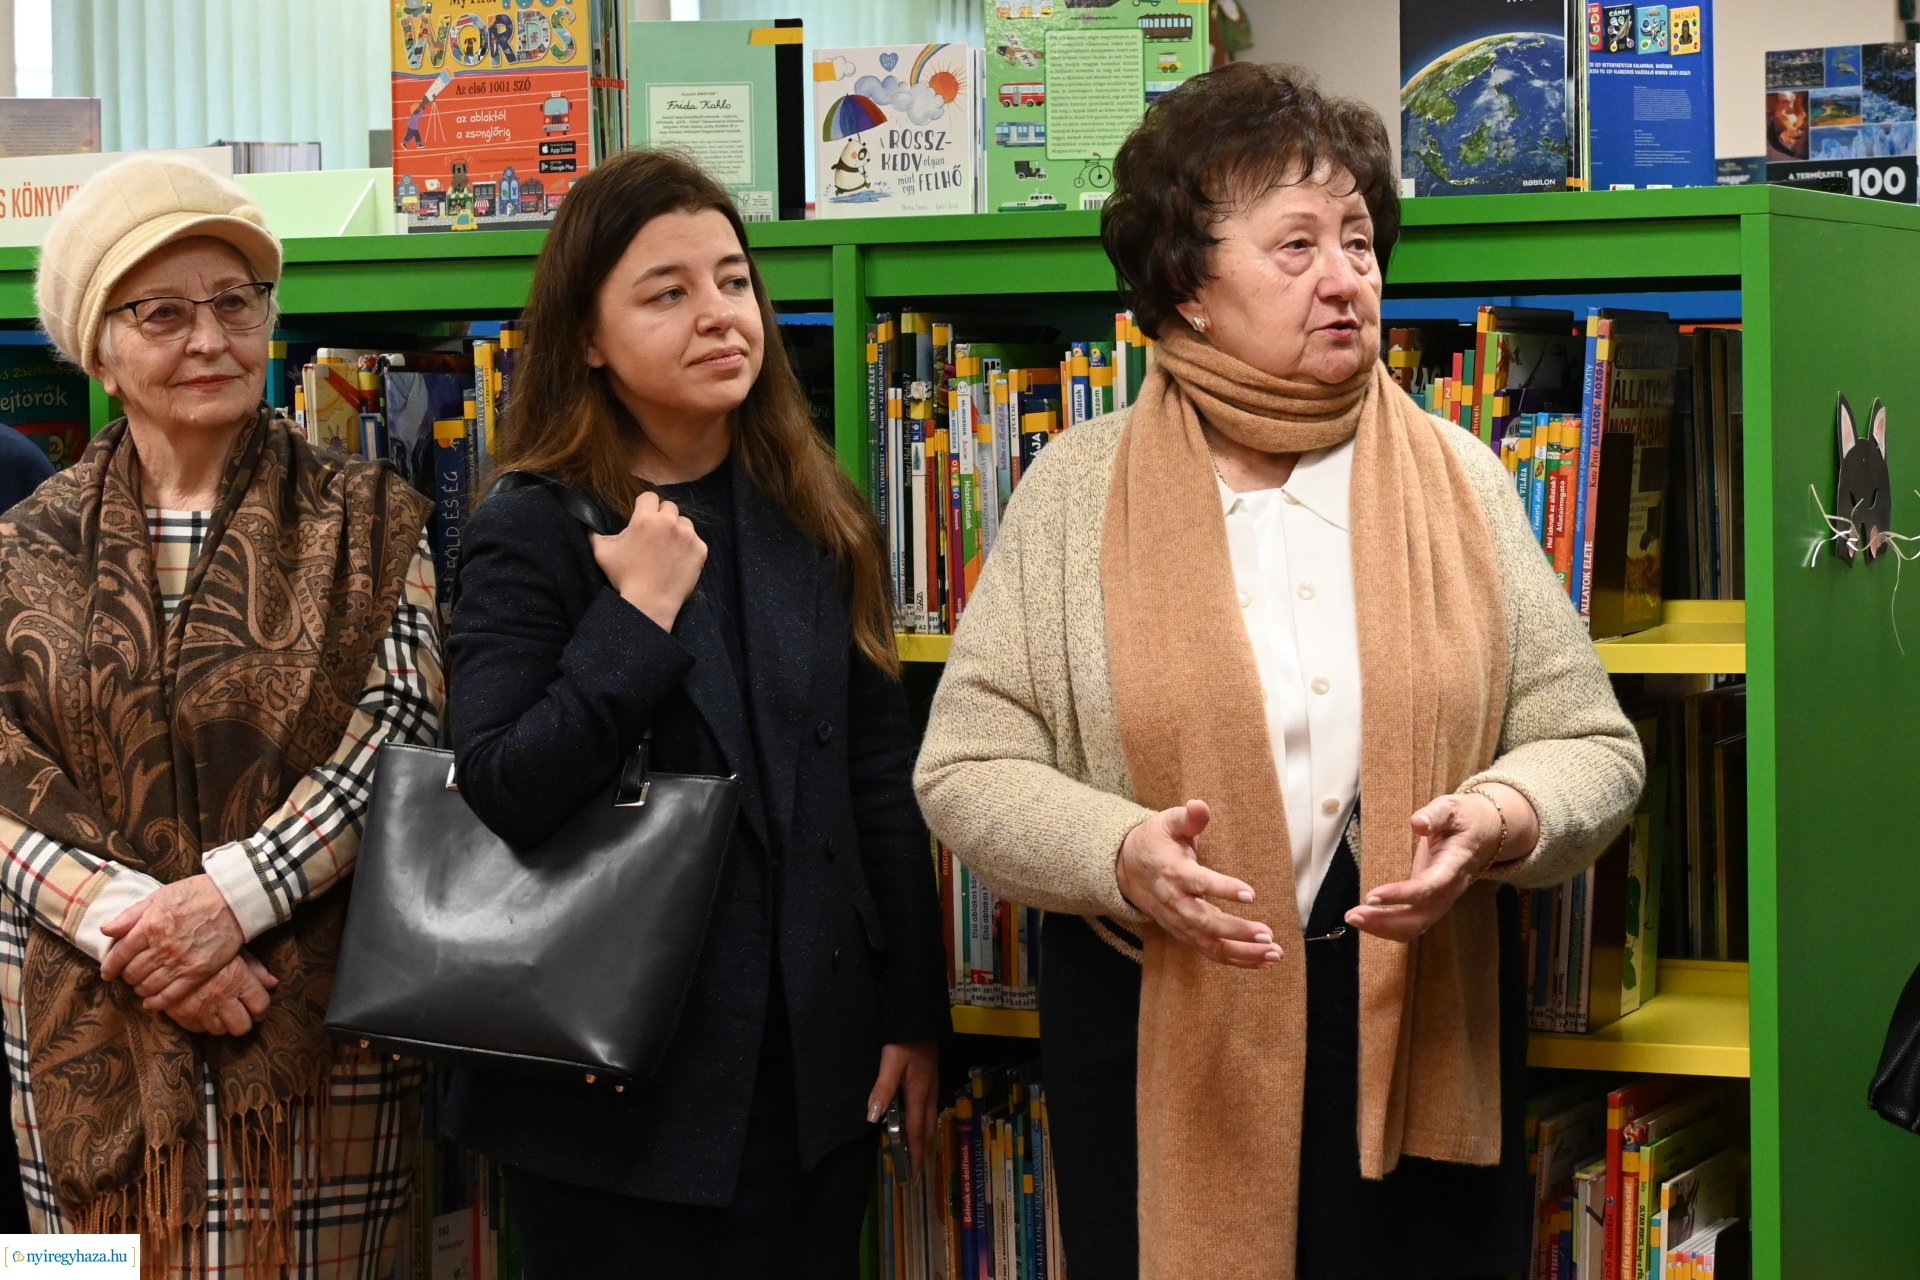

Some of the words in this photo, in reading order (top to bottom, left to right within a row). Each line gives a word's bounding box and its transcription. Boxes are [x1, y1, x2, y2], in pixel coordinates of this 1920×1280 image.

[400, 6, 577, 69] WORDS
[455, 84, 466, 95] Az
[468, 82, 487, 95] első
[489, 82, 511, 94] 1001
[512, 77, 532, 92] SZÓ
[456, 114, 467, 124] az
[470, 109, 507, 123] ablaktól
[666, 100, 698, 111] Frida
[699, 98, 732, 110] Kahlo
[456, 131, 463, 140] a
[888, 128, 953, 151] ROSSZ-
[881, 151, 923, 173] KEDV
[922, 154, 946, 170] olyan
[902, 184, 916, 196] egy
[918, 164, 963, 193] FELHŐ
[1848, 166, 1907, 197] 100
[11, 182, 82, 218] KÖNYVE
[868, 385, 876, 398] AZ
[1075, 388, 1084, 419] állatok
[868, 399, 877, 422] ILYEN
[1589, 470, 1597, 488] Kate
[1594, 361, 1604, 400] MOZGÁ
[466, 420, 474, 446] VILÁGO
[878, 453, 886, 488] TERMÉSZET
[951, 459, 960, 500] OLVASÓ
[963, 480, 974, 530] Háziállatok
[1549, 475, 1557, 505] állatok?
[1549, 504, 1555, 513] az
[1547, 513, 1555, 537] laknak
[1546, 537, 1554, 549] Hol
[970, 890, 979, 923] ablakos
[982, 891, 990, 924] ablakos
[961, 1145, 971, 1181] delfinek
